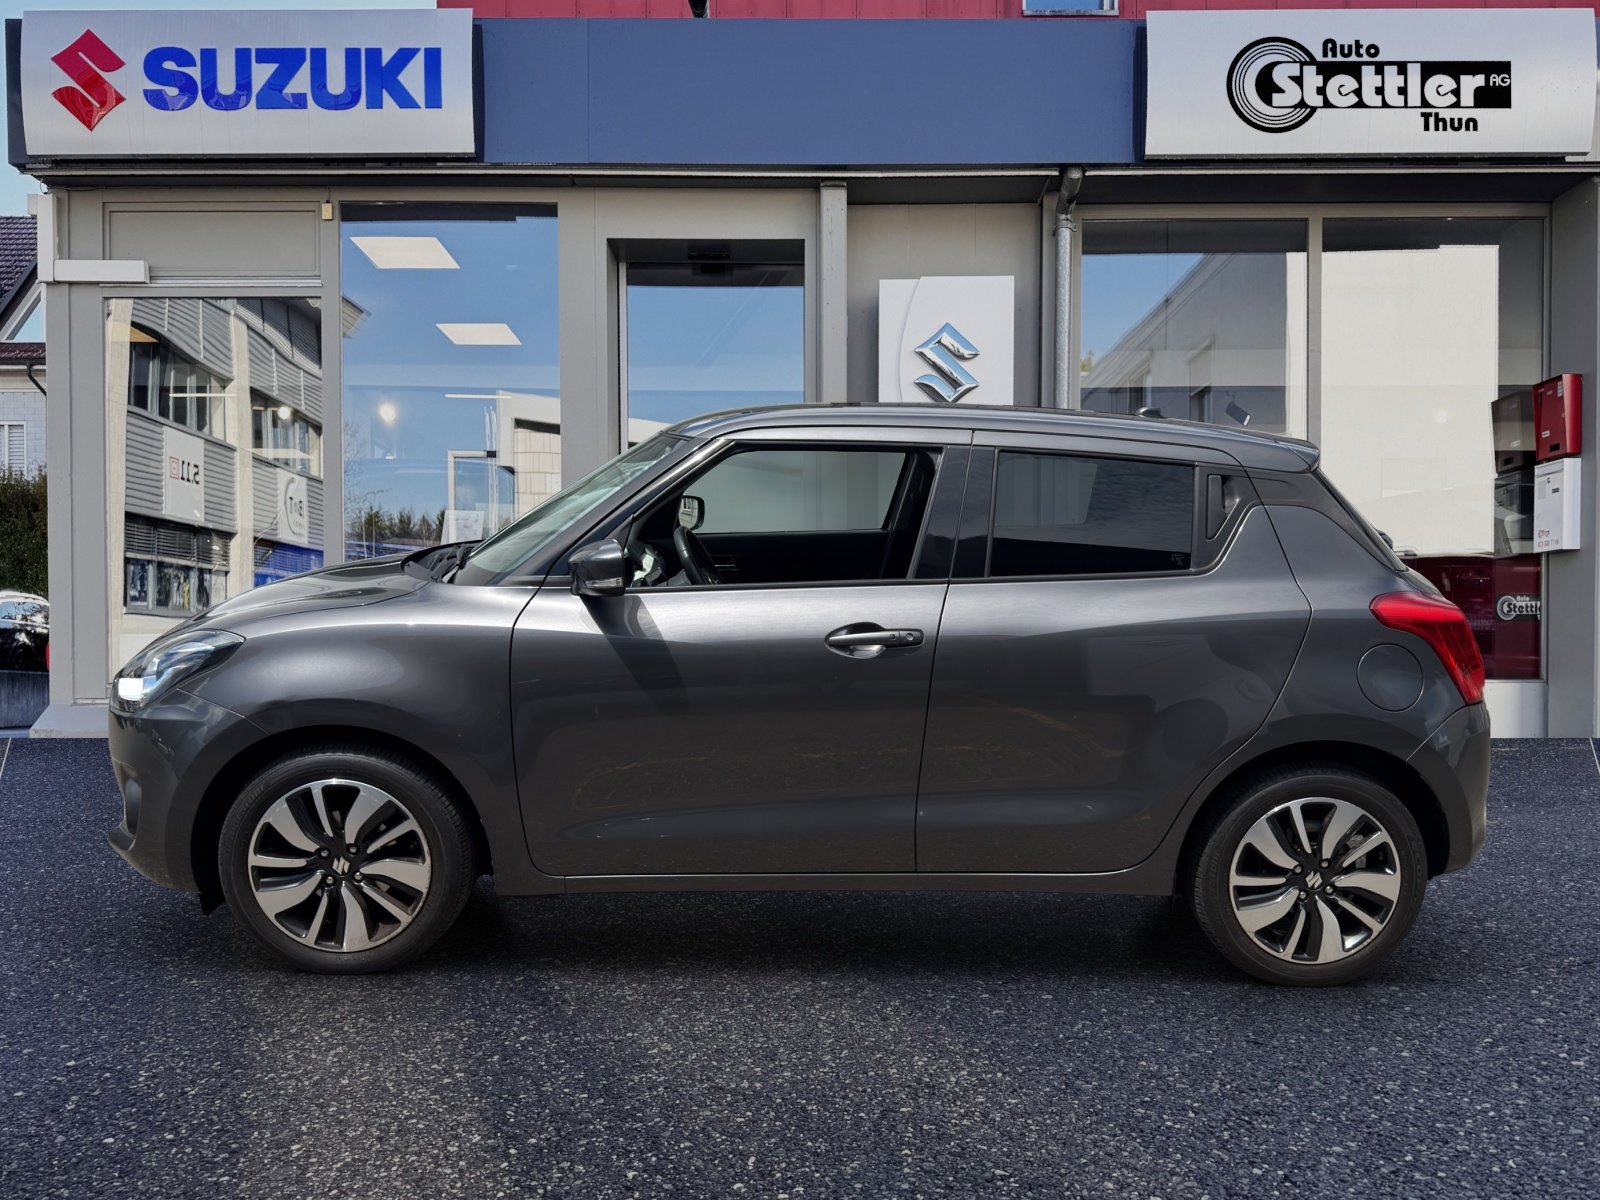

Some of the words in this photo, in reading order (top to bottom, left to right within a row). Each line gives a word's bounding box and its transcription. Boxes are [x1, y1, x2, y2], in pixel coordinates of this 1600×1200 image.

[1322, 38, 1380, 59] Auto
[143, 47, 443, 111] SUZUKI
[1271, 62, 1486, 108] Stettler
[1489, 73, 1511, 87] AG
[1420, 111, 1479, 132] Thun
[1506, 602, 1541, 614] Stettl
